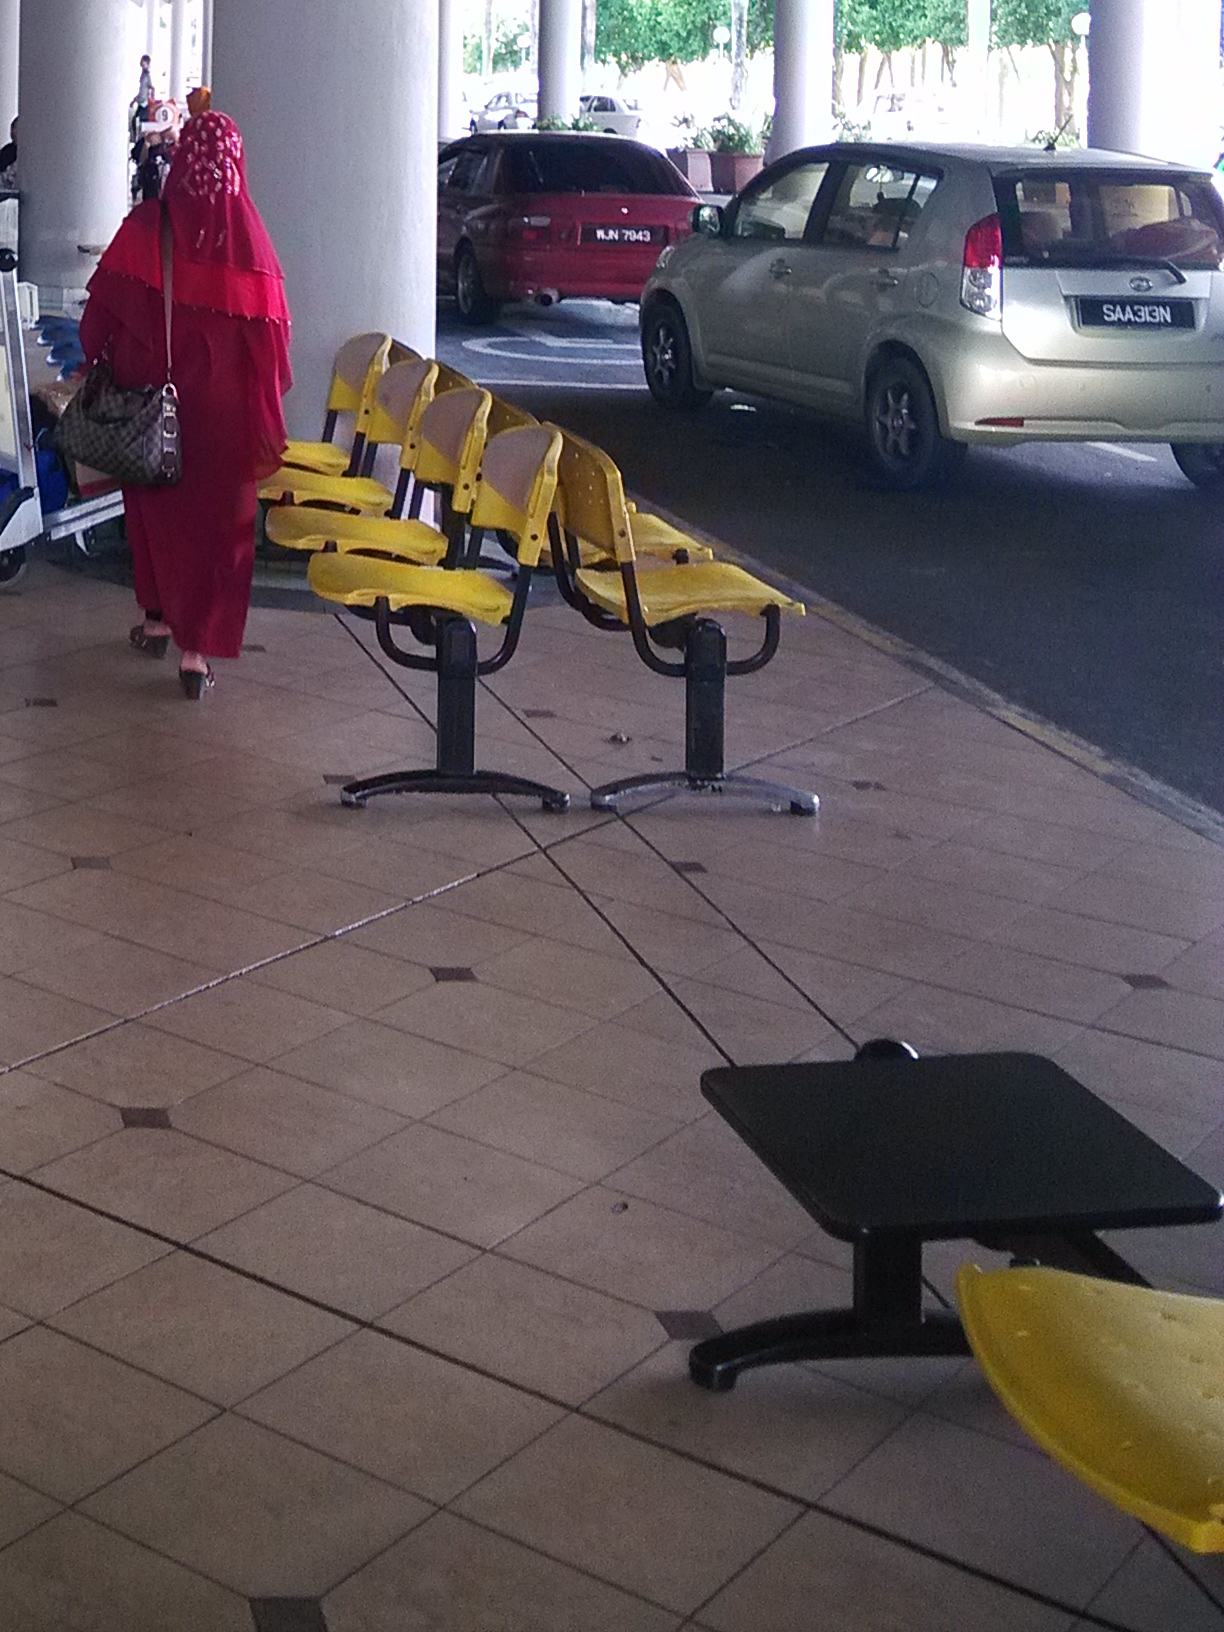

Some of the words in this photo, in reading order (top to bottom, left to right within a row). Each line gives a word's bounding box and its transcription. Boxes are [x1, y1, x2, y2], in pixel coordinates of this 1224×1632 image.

[161, 109, 169, 122] 9
[596, 228, 619, 241] WJN
[1102, 304, 1172, 324] SAA313N
